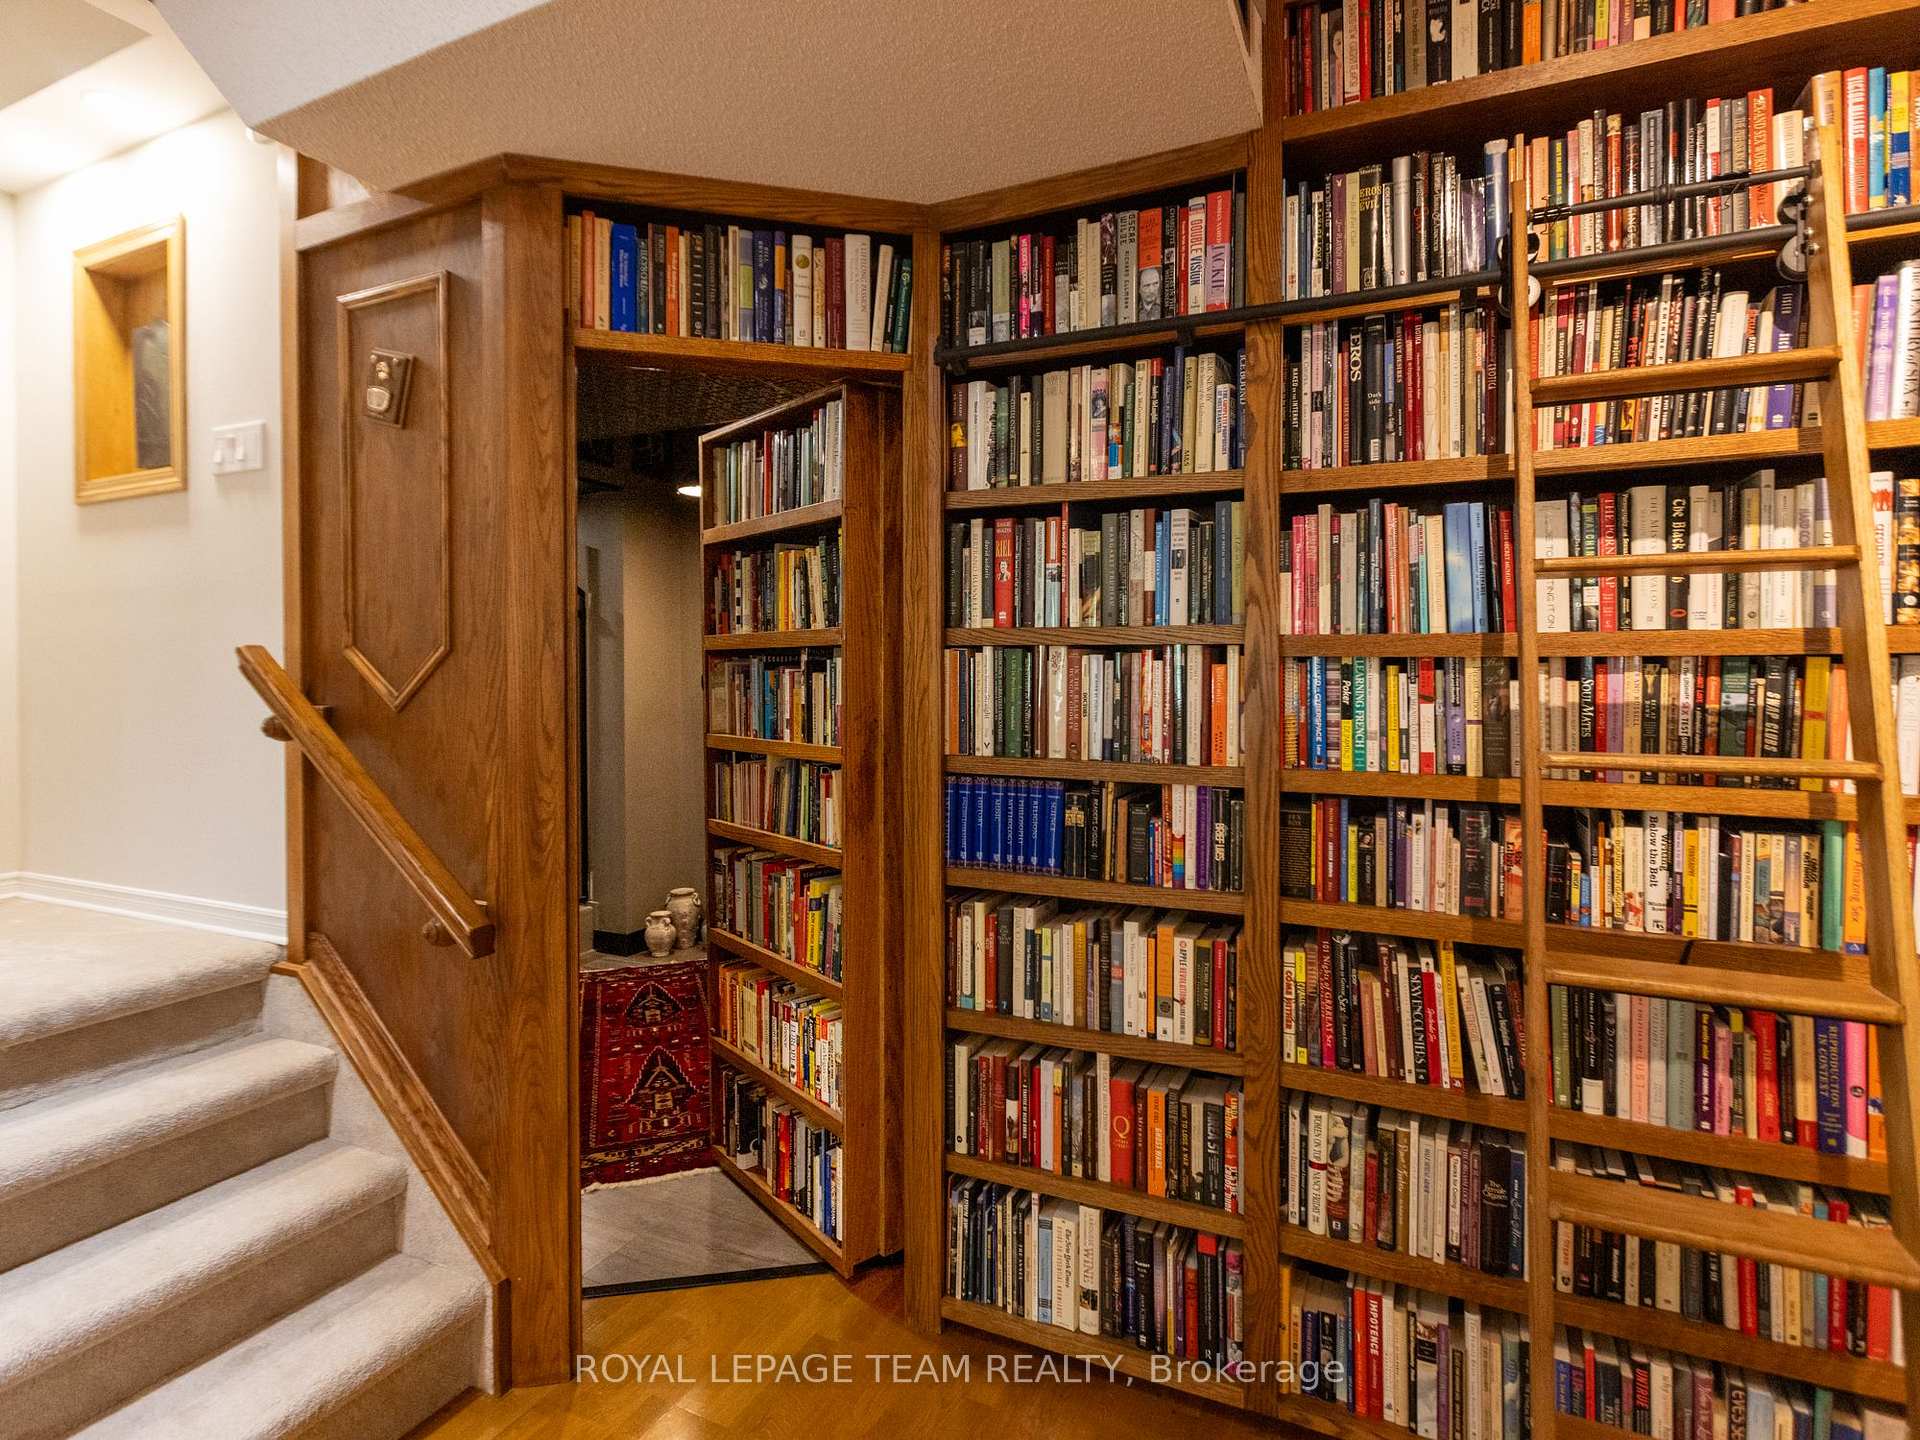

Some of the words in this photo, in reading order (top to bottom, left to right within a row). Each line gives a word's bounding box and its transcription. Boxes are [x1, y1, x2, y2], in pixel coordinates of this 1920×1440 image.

[1849, 75, 1865, 103] VICTOR
[1360, 184, 1382, 197] EROS
[1360, 199, 1380, 212] EVIL
[1190, 219, 1203, 255] DOUBLE
[1190, 255, 1202, 287] VISION
[1211, 244, 1225, 292] JACKIE
[1336, 258, 1344, 283] ADVISOR
[1616, 304, 1624, 317] The
[1414, 324, 1422, 345] EROTICA
[1350, 333, 1362, 383] EROS
[1205, 375, 1213, 403] NEWBY
[1239, 353, 1248, 405] ICEBOUND
[1488, 363, 1497, 391] EROTICA
[1605, 499, 1616, 522] THE
[1671, 498, 1687, 518] The
[1604, 524, 1616, 555] PORN
[1671, 521, 1687, 551] Black
[1503, 541, 1511, 561] SECRET
[1504, 561, 1512, 586] MUSEUM
[1355, 659, 1365, 708] LEARNING
[1681, 666, 1690, 677] The
[1342, 679, 1352, 705] Poker
[1580, 677, 1595, 704] SOUL
[1683, 677, 1691, 701] Ultimate
[1681, 702, 1692, 716] SEX
[1764, 691, 1781, 720] SWAP
[1355, 710, 1366, 748] FRENCH
[1580, 704, 1595, 739] MATES
[1681, 717, 1692, 736] TEST
[1763, 722, 1779, 753] CLUBS
[1214, 823, 1225, 844] BRIEF
[1648, 815, 1659, 847] Below
[1214, 845, 1225, 862] LIVES
[1506, 842, 1515, 873] Libris
[1615, 839, 1623, 867] BOUND
[1648, 848, 1659, 865] the
[1658, 834, 1669, 872] Writing
[1615, 867, 1623, 885] AND
[1648, 866, 1659, 888] Belt
[1802, 851, 1810, 889] CASTANEDA
[1809, 857, 1818, 883] CARLOS
[1848, 860, 1863, 903] Amazing
[1851, 906, 1862, 922] Sex
[1322, 940, 1330, 953] 101
[1320, 955, 1331, 982] Nights
[1284, 970, 1293, 995] COME
[1410, 973, 1422, 999] SEXY
[1283, 997, 1293, 1031] HITHER
[1337, 994, 1348, 1013] Sex
[1412, 999, 1425, 1064] ENCOUNTERS
[1817, 1033, 1829, 1045] IN
[1818, 1047, 1829, 1098] CONTEXT
[1828, 1024, 1840, 1107] REPRODUCTION
[1229, 1097, 1238, 1120] LINDA
[1181, 1120, 1188, 1129] TO
[1206, 1112, 1217, 1141] AREA
[1313, 1114, 1322, 1138] WOMEN
[1154, 1128, 1162, 1149] GHOST
[1207, 1141, 1219, 1155] 51
[1313, 1138, 1322, 1148] ON
[1155, 1149, 1163, 1170] WARS
[1182, 1154, 1190, 1167] WAR
[1313, 1149, 1322, 1161] TOP
[1451, 1157, 1459, 1177] Thanks
[1313, 1170, 1322, 1192] NANCY
[1313, 1192, 1322, 1216] FRIDAY
[1450, 1187, 1459, 1209] Coming
[1063, 1253, 1071, 1269] York
[1368, 1299, 1379, 1357] IMPOTENCE
[1635, 1368, 1648, 1409] UNTRUE
